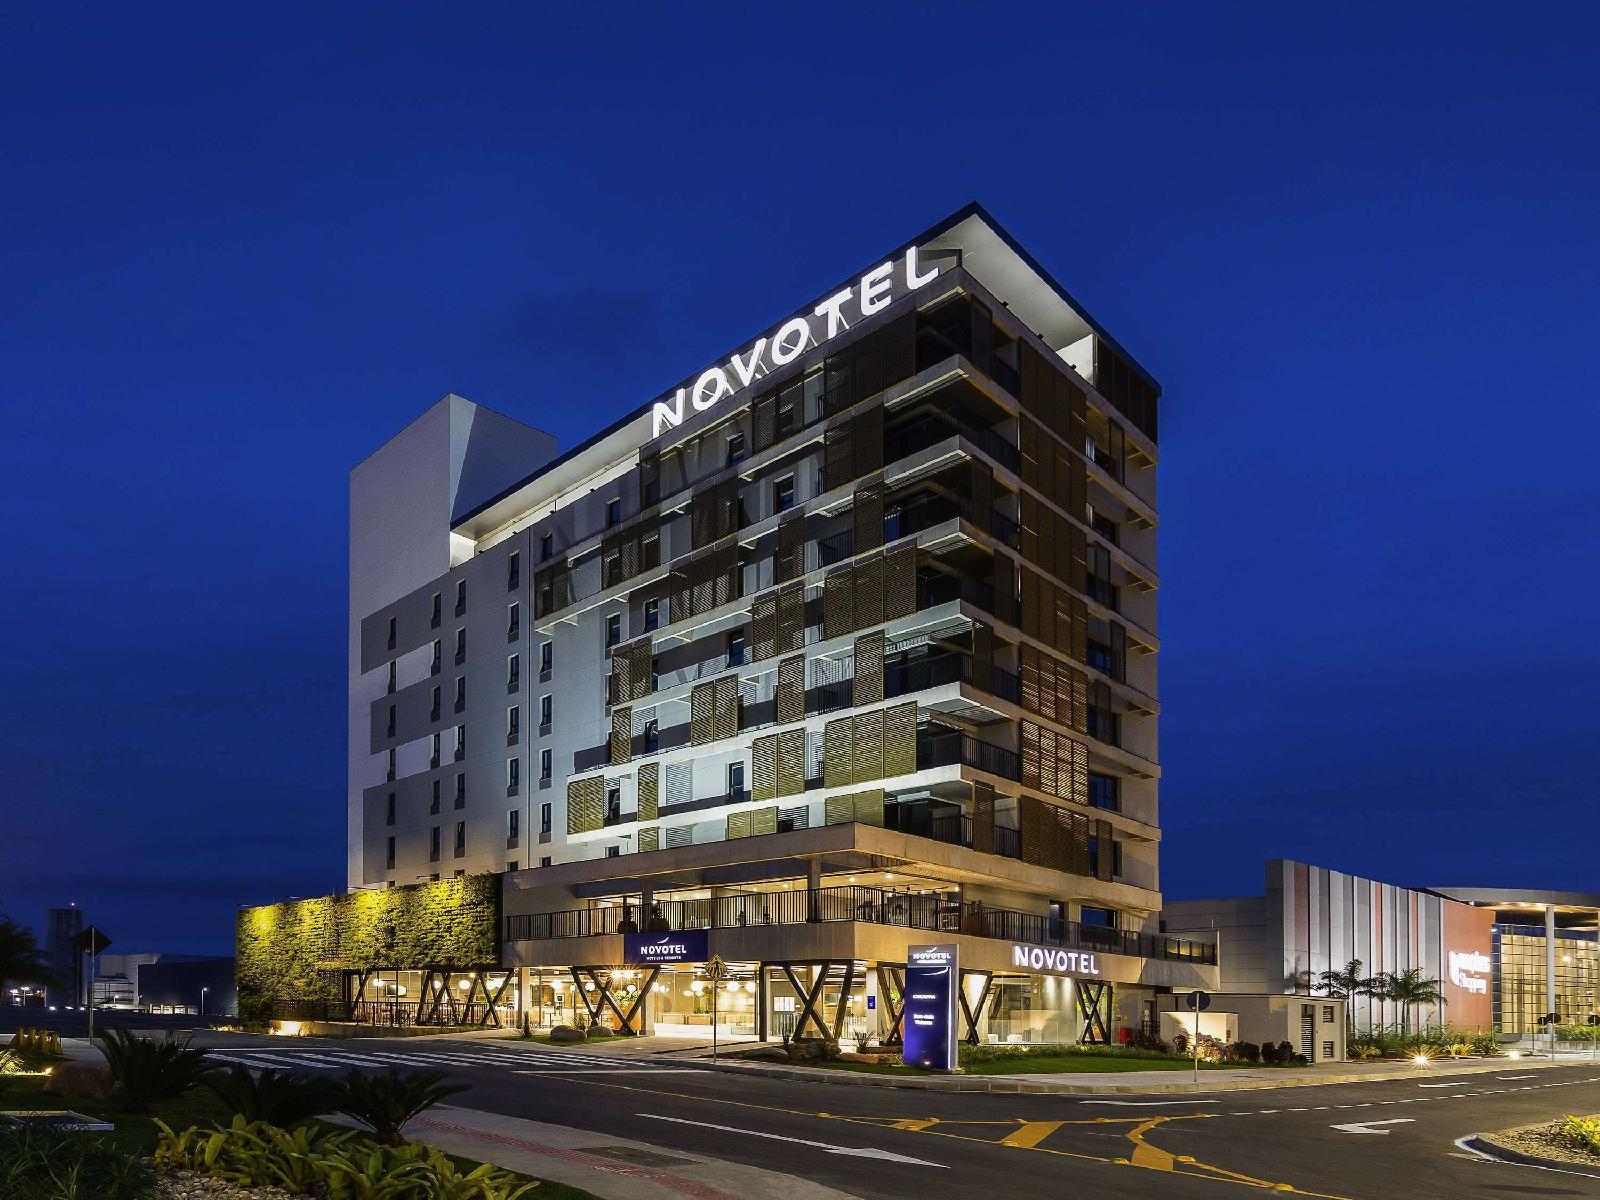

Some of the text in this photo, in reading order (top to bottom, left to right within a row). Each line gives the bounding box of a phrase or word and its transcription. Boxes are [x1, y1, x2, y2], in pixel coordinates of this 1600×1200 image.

[652, 245, 939, 438] NOVOTEL
[640, 945, 687, 954] NOVOTEL
[1014, 945, 1099, 975] NOVOTEL
